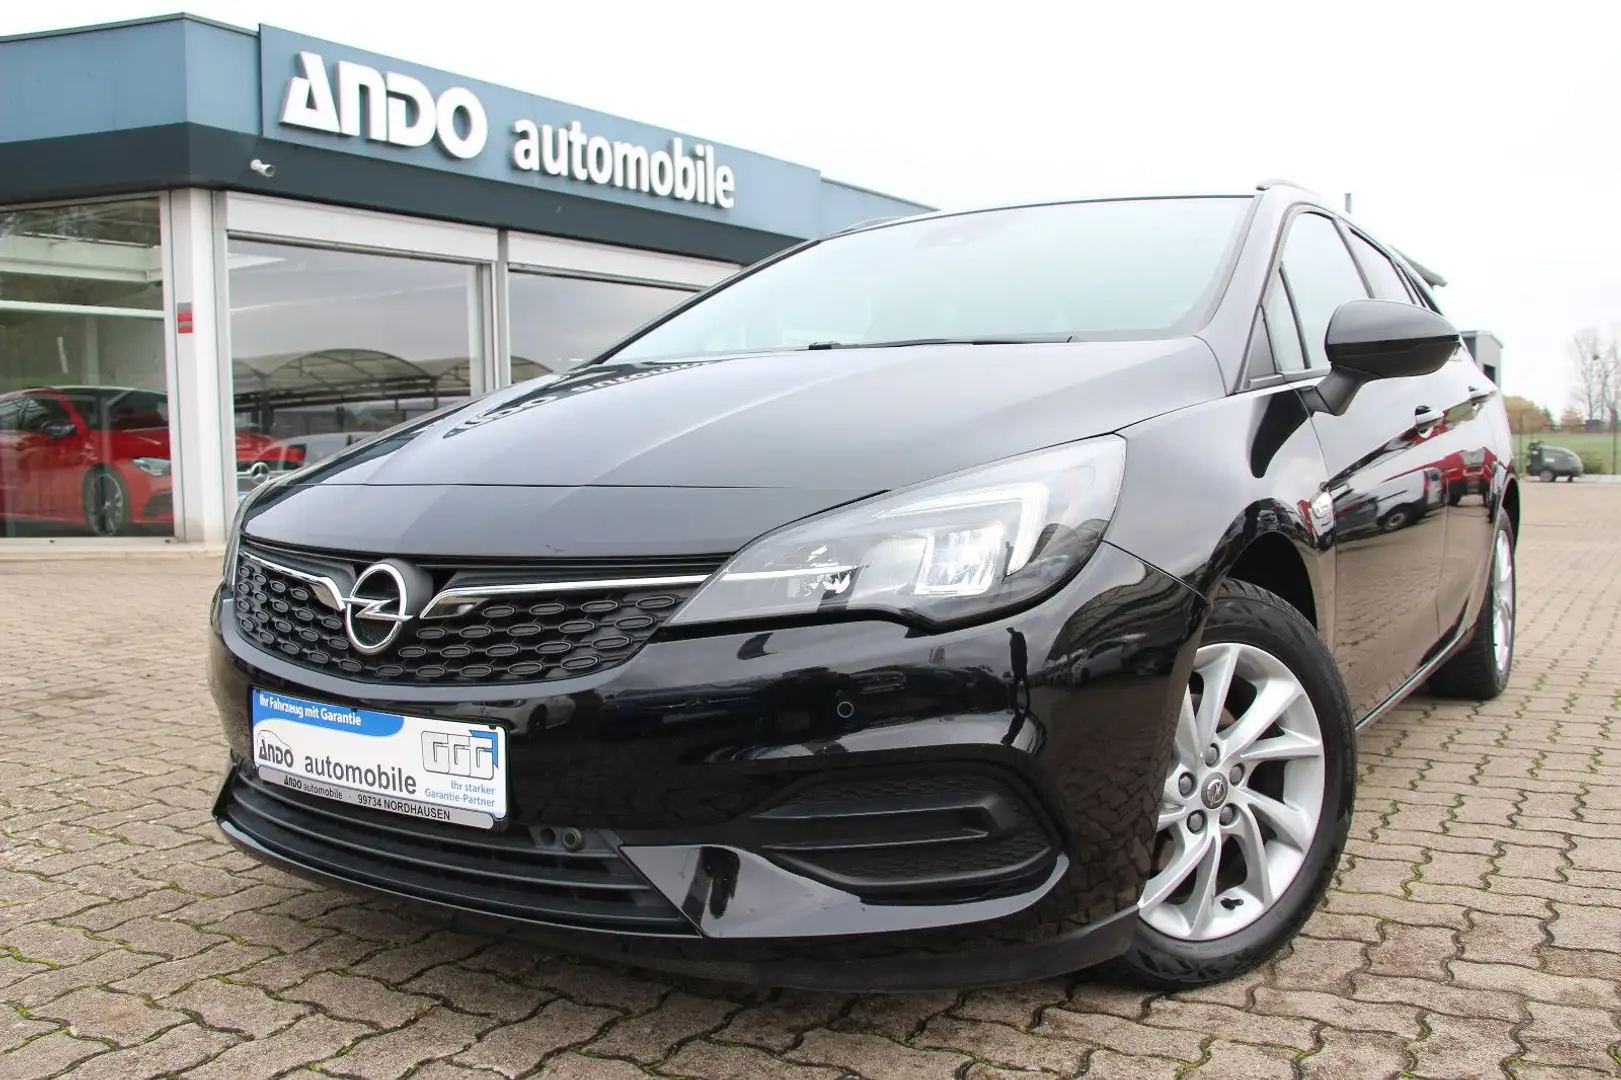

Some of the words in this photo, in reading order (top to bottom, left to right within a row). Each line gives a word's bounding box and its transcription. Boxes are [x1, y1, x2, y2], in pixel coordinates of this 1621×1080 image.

[279, 50, 488, 159] ANDO
[511, 118, 735, 209] automobile
[259, 693, 269, 708] Ihr
[270, 697, 304, 719] Fahrzeug
[305, 705, 319, 719] mit
[320, 708, 361, 726] Garantie
[259, 739, 294, 768] ANDO
[304, 755, 417, 795] automobile
[284, 775, 302, 789] ANDO
[303, 783, 343, 800] automobile
[357, 794, 382, 808] 99734
[383, 800, 451, 821] NORDHAUSEN
[424, 788, 496, 808] Garantie-Partner
[450, 780, 462, 790] Ihr
[464, 782, 496, 796] starker
